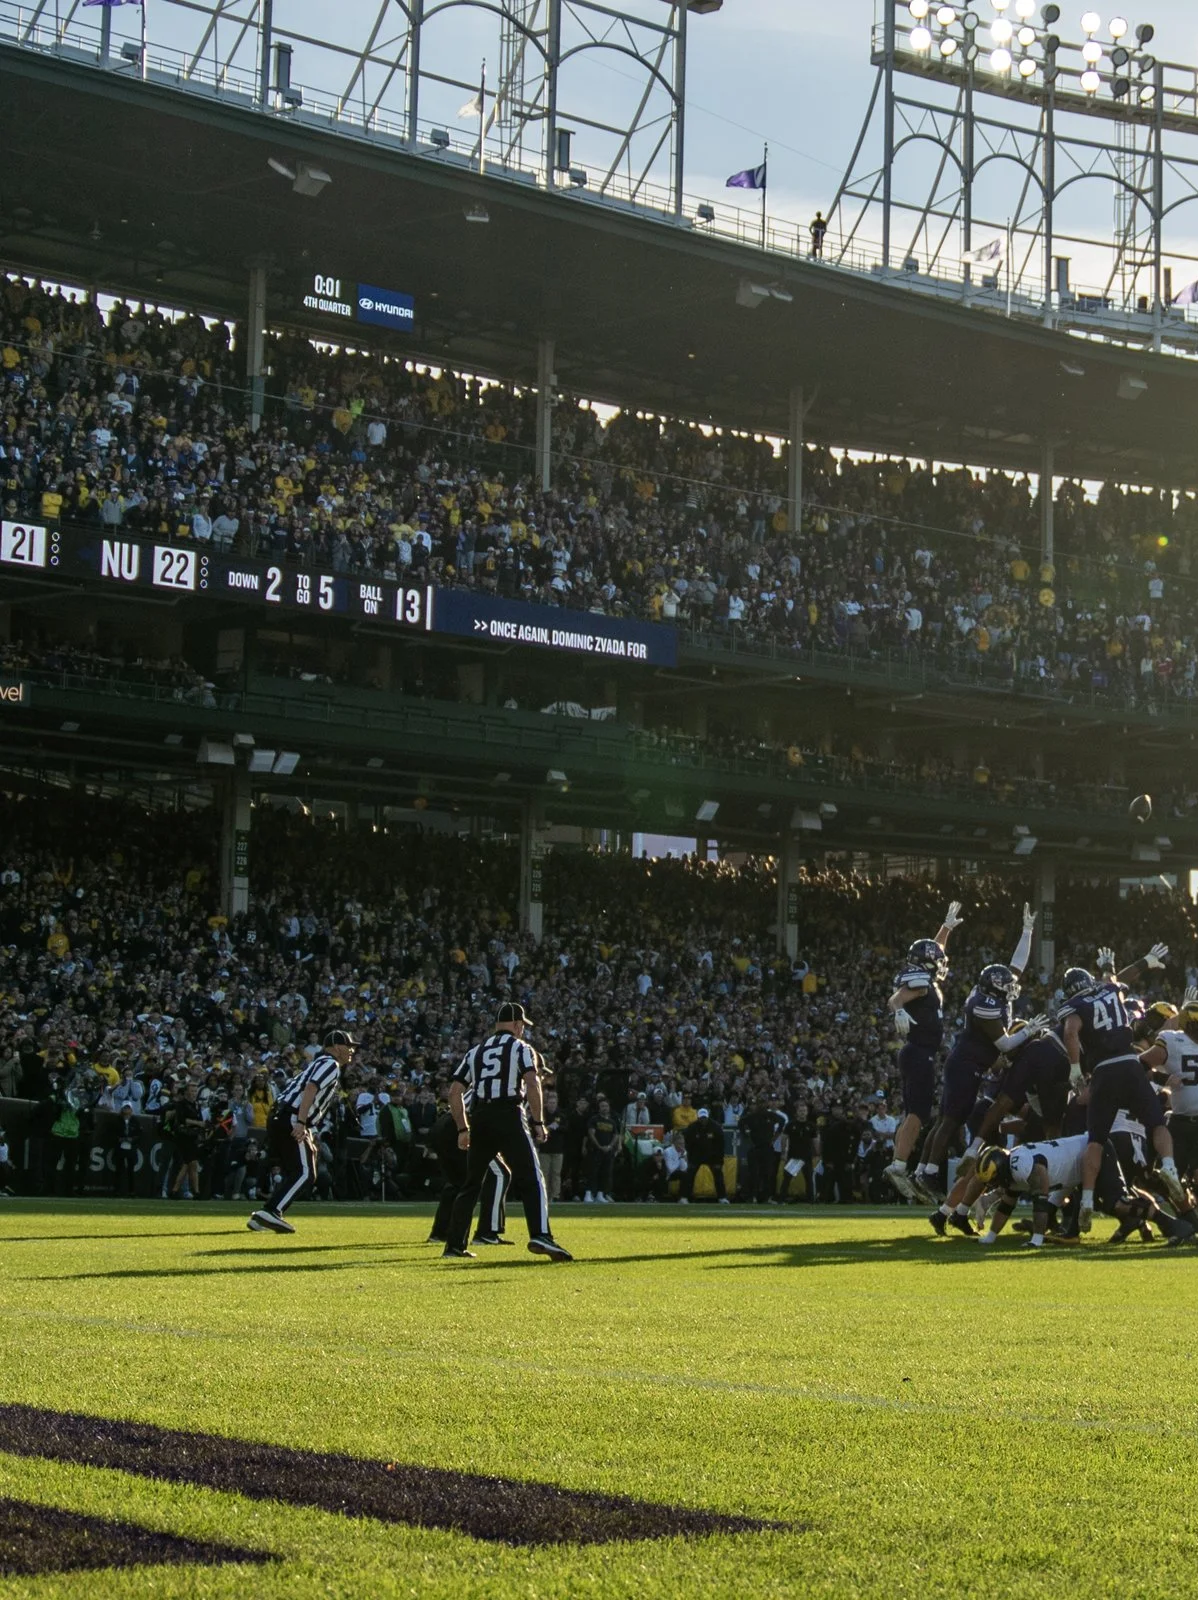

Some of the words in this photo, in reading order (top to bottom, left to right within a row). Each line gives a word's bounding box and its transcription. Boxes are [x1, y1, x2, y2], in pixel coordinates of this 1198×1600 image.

[314, 274, 341, 298] 0:01
[303, 295, 318, 309] 4TH
[318, 298, 352, 316] QUARTER
[375, 301, 414, 319] HYUNDAI
[11, 526, 35, 562] 21
[101, 540, 140, 581] NU
[160, 550, 190, 586] 22
[228, 571, 259, 590] DOWN
[265, 566, 282, 602] 2
[297, 574, 310, 590] TO
[296, 589, 310, 604] GO
[318, 575, 334, 610] 5
[360, 584, 382, 601] BALL
[364, 600, 378, 615] ON
[396, 587, 421, 624] 13
[490, 619, 517, 639] ONCE
[518, 625, 551, 646] AGAIN,
[552, 630, 593, 651] DOMINIC
[595, 636, 625, 656] ZVADA
[627, 641, 647, 659] FOR
[1093, 991, 1123, 1031] 47
[480, 1046, 503, 1079] S
